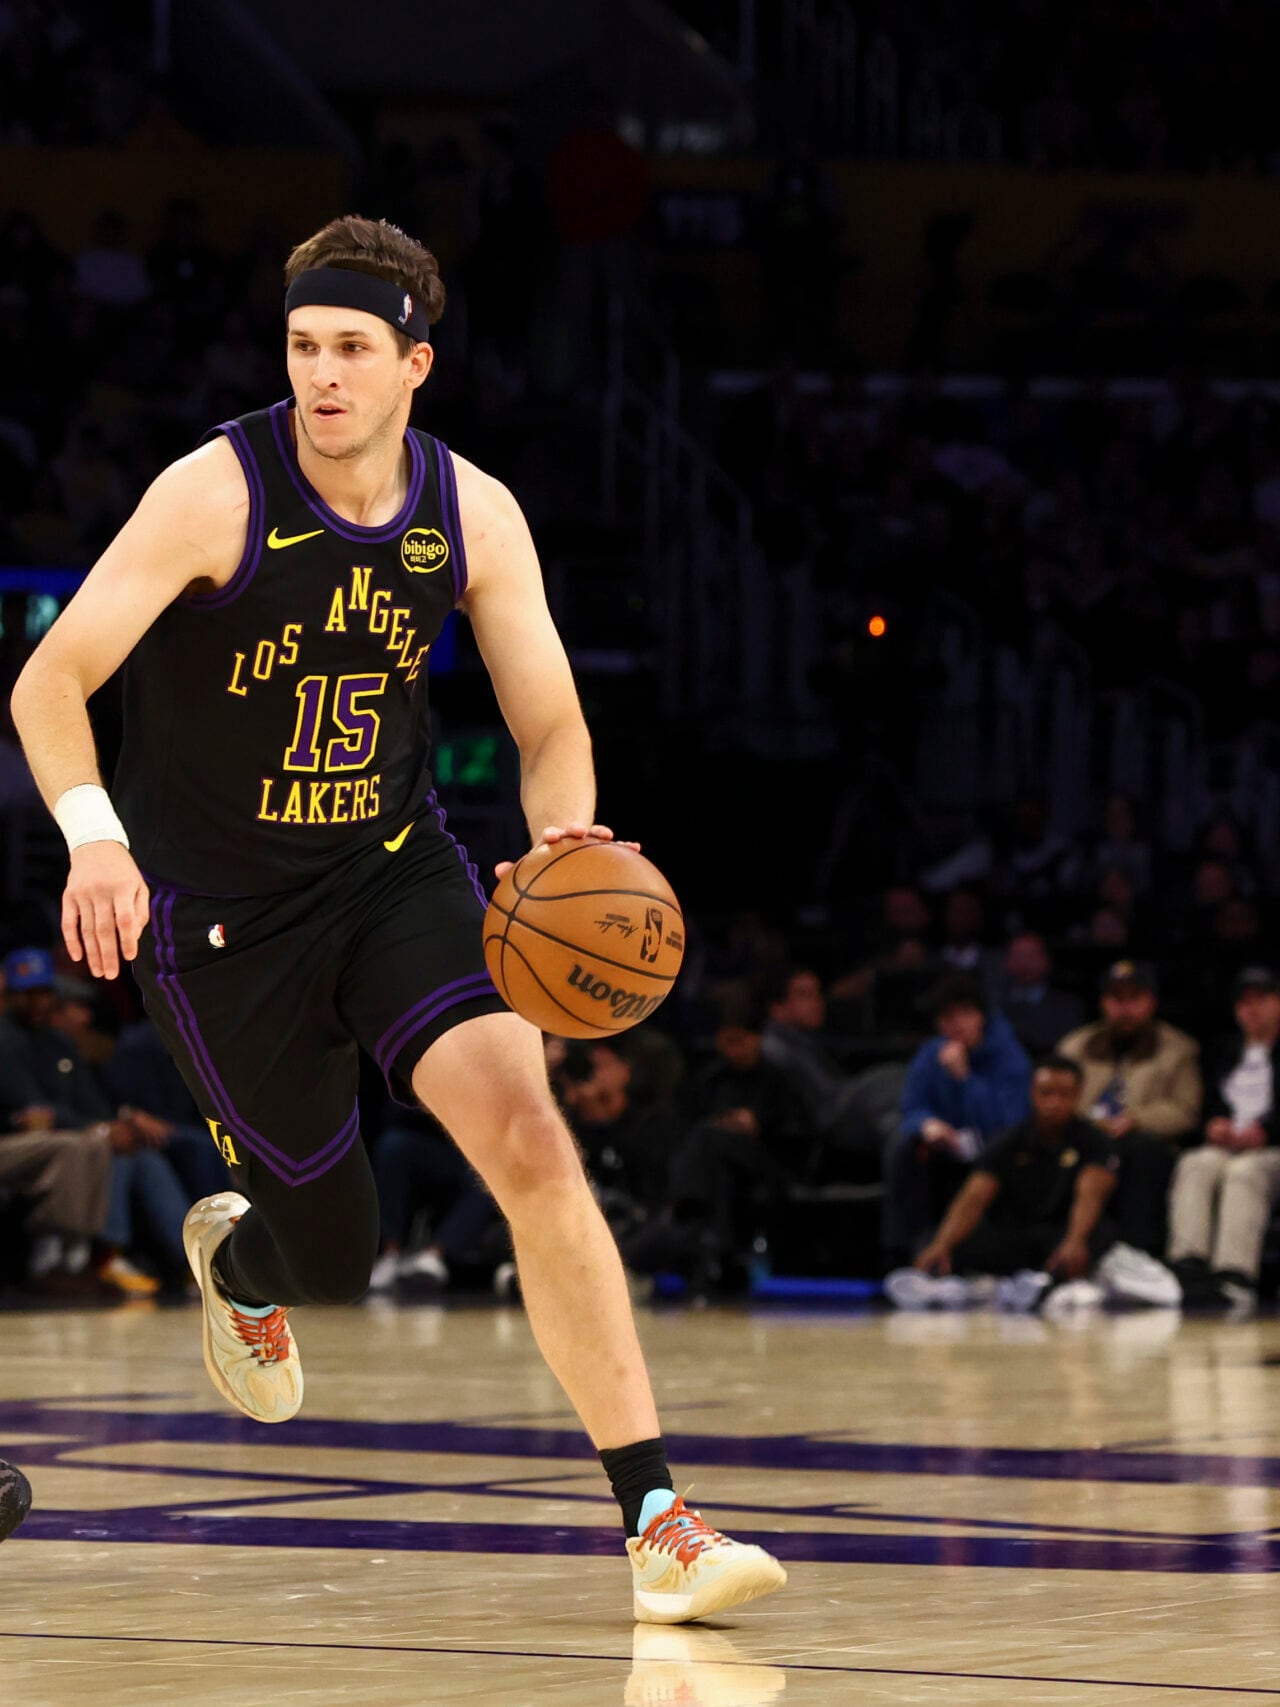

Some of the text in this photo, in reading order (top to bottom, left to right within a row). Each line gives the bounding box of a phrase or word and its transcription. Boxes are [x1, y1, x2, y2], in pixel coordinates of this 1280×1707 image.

[404, 539, 445, 560] bibigo
[228, 567, 430, 696] LOS ANGELE
[283, 673, 389, 773] 15
[258, 774, 380, 824] LAKERS
